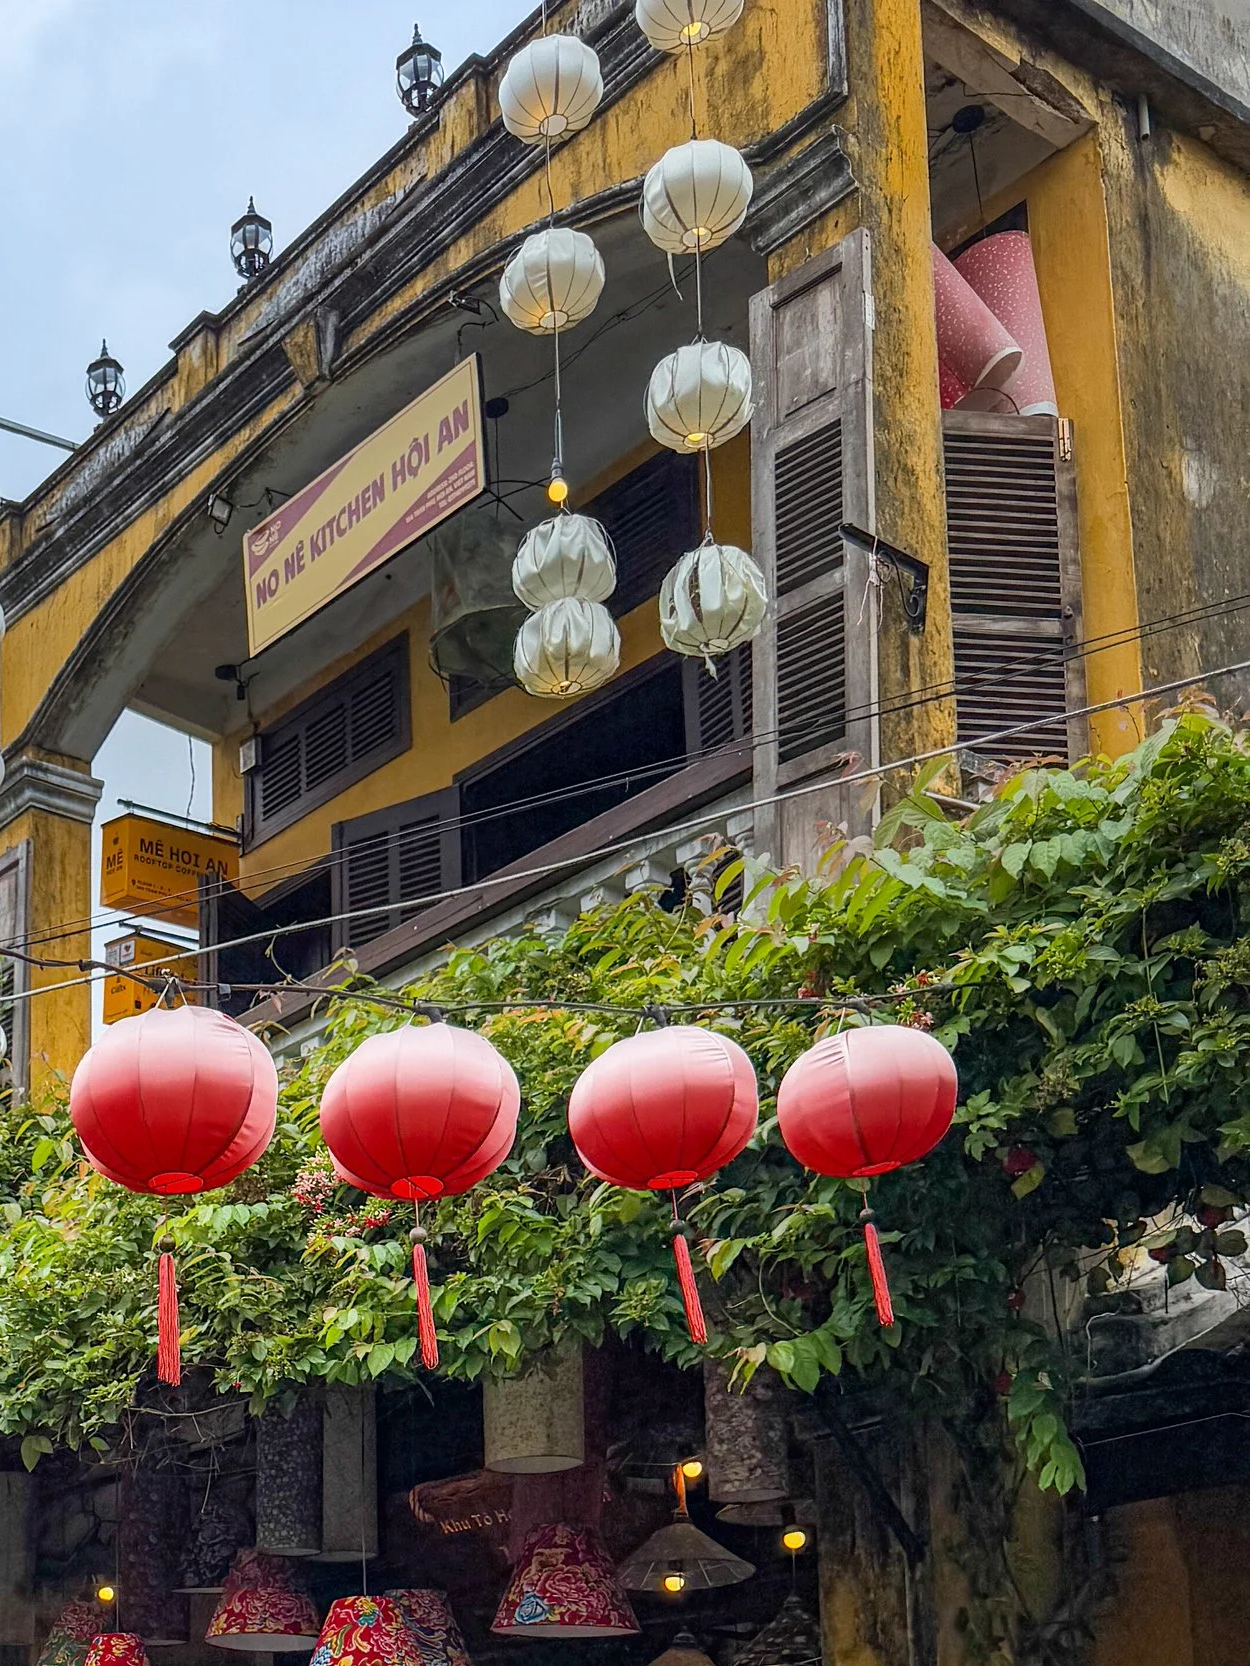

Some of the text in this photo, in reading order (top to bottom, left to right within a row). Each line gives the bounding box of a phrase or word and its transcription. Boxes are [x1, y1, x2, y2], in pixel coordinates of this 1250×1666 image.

[255, 568, 279, 609] NO
[284, 540, 305, 585] NÊ
[309, 472, 386, 562] KITCHEN
[391, 432, 430, 492] HỘI
[437, 399, 470, 455] AN
[106, 848, 123, 869] MÊ
[139, 838, 228, 875] MÊ HOI AN
